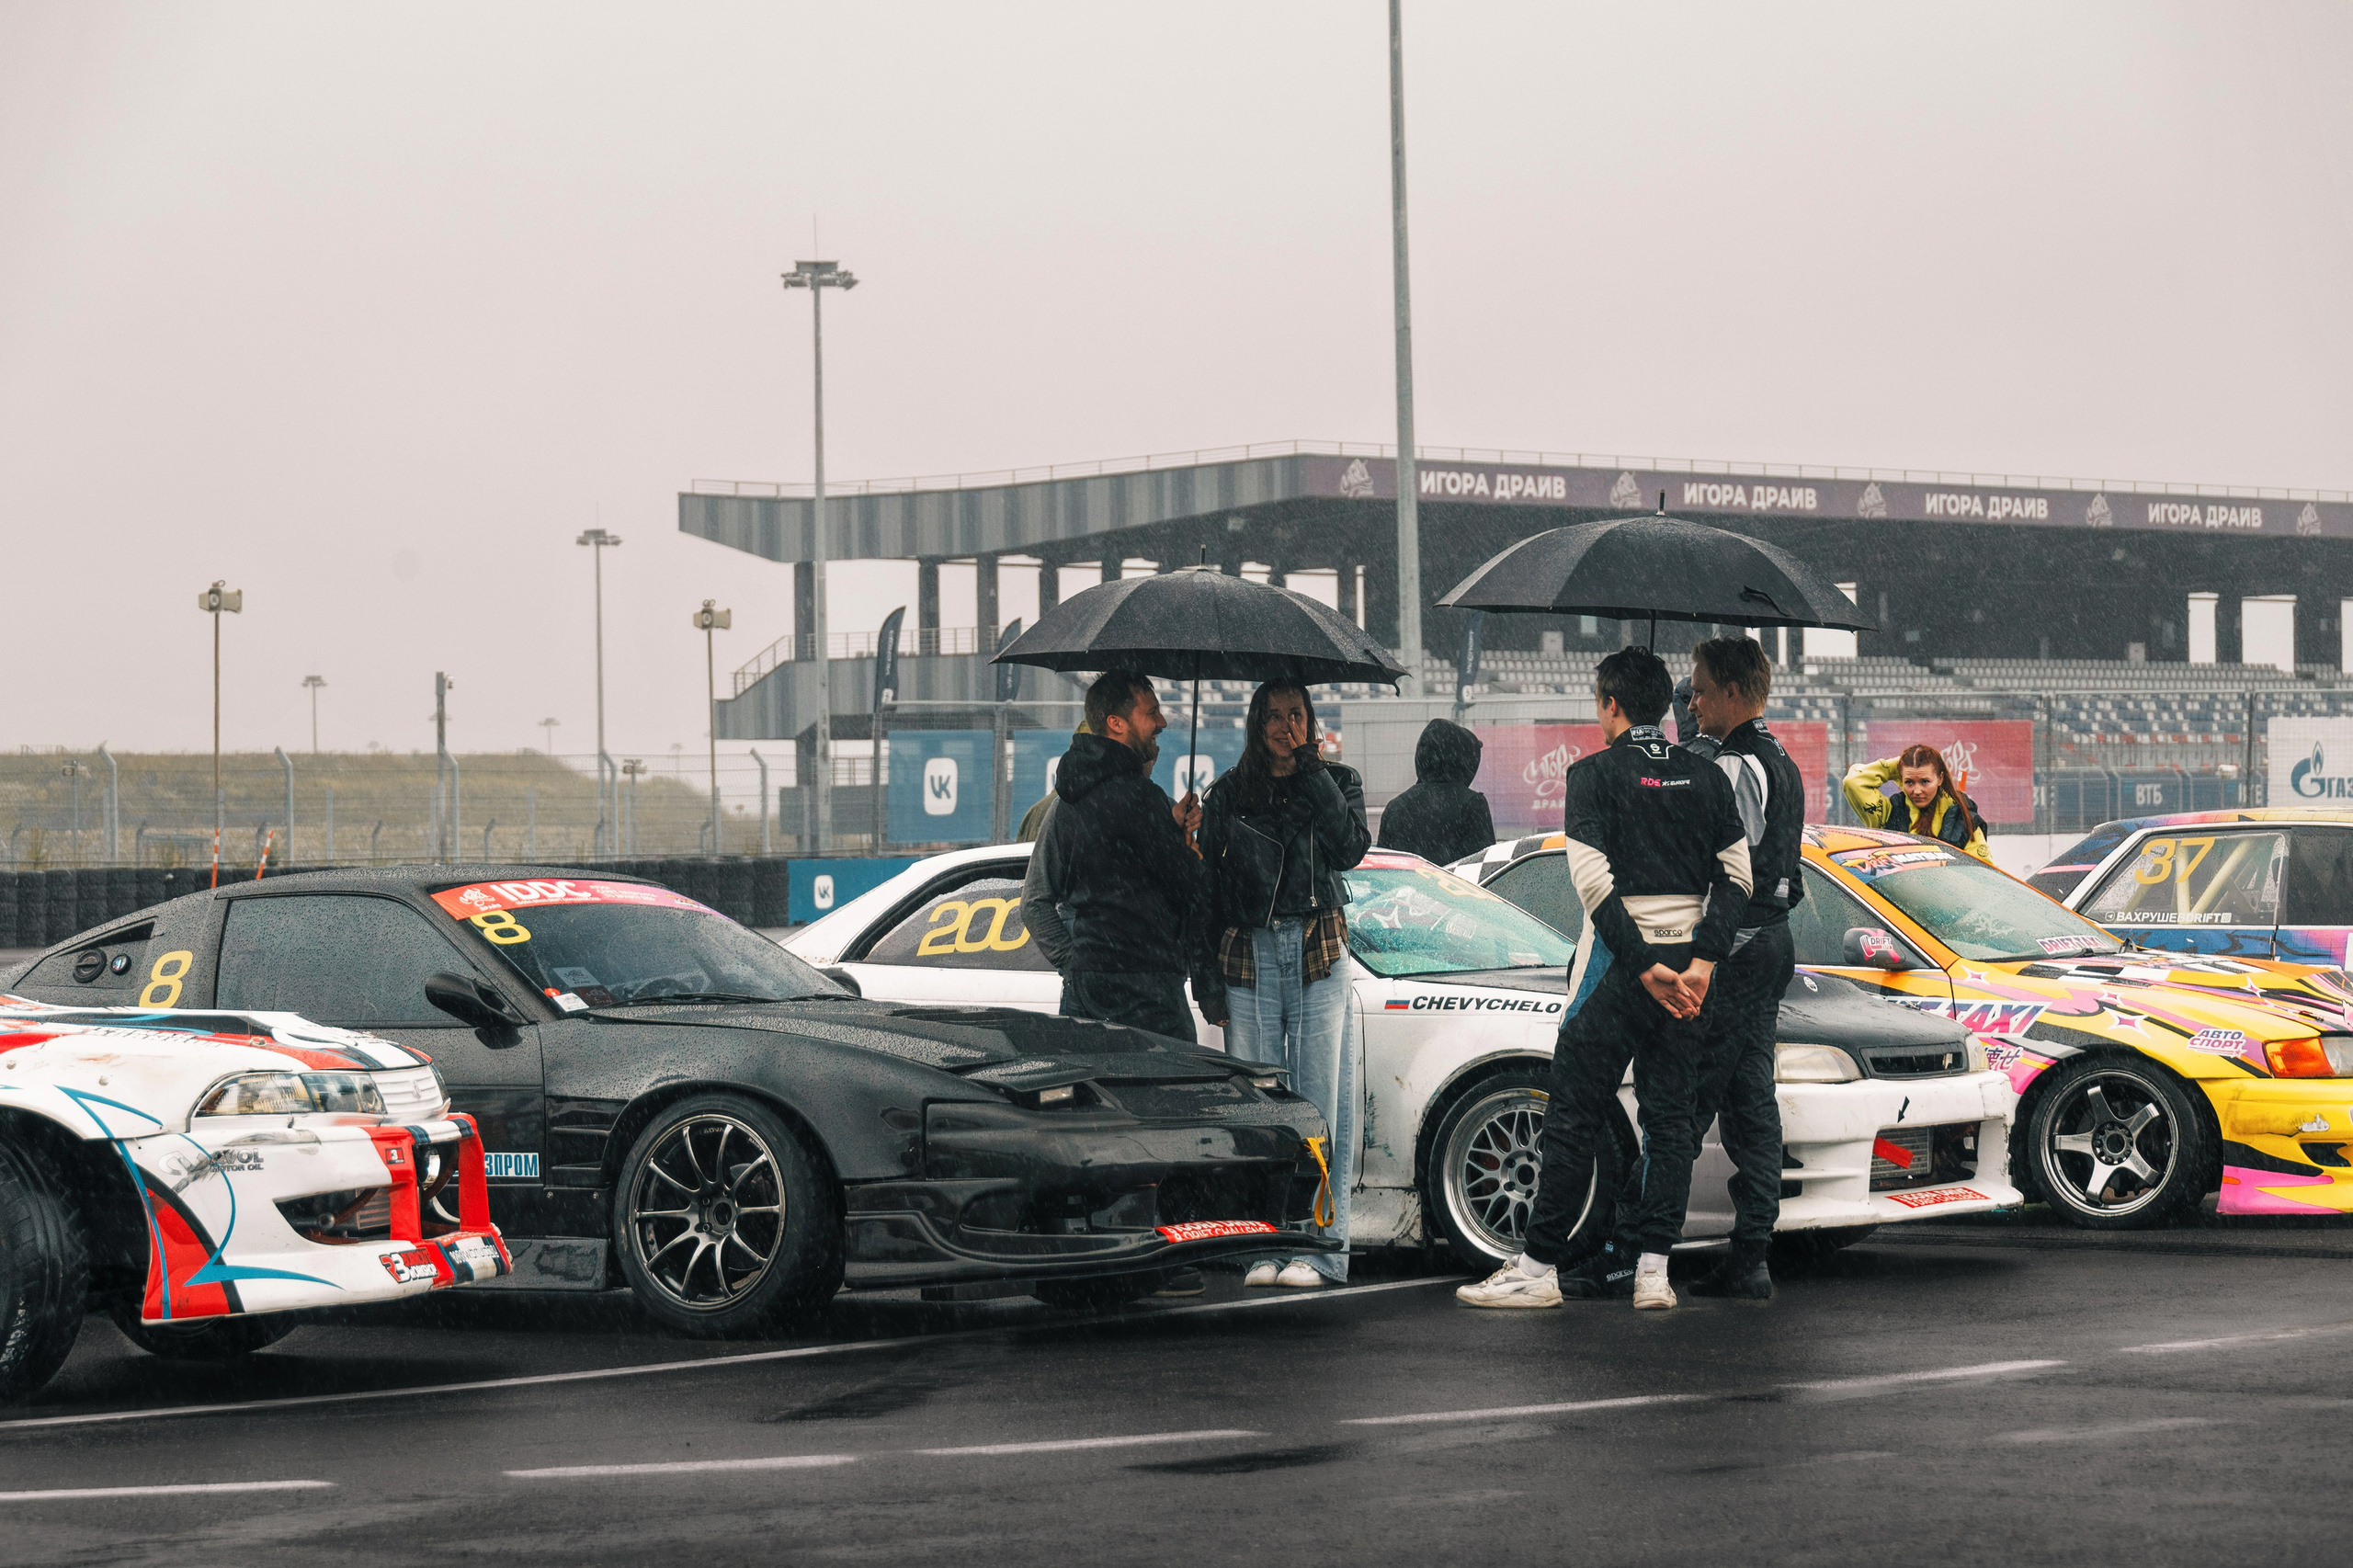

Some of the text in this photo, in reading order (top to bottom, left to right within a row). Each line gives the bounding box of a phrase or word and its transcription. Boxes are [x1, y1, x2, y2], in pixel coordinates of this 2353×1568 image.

[1421, 471, 1566, 499] ИГОРА ДРАЙВ
[1684, 483, 1817, 510] ИГОРА ДРАЙВ
[1926, 493, 2048, 520] ИГОРА ДРАЙВ
[2148, 503, 2262, 528] ИГОРА ДРАЙВ
[930, 775, 951, 800] VK
[1641, 778, 1661, 787] RDS
[2136, 783, 2164, 805] ВТБ
[2134, 836, 2216, 884] 37
[490, 881, 592, 902] IDDC
[470, 910, 531, 945] 8
[139, 950, 194, 1008] 8
[2189, 1038, 2244, 1050] СПОРТ
[2198, 1029, 2243, 1040] АВТО
[247, 1163, 264, 1171] OIL
[484, 1153, 538, 1176] ЗПРОМ
